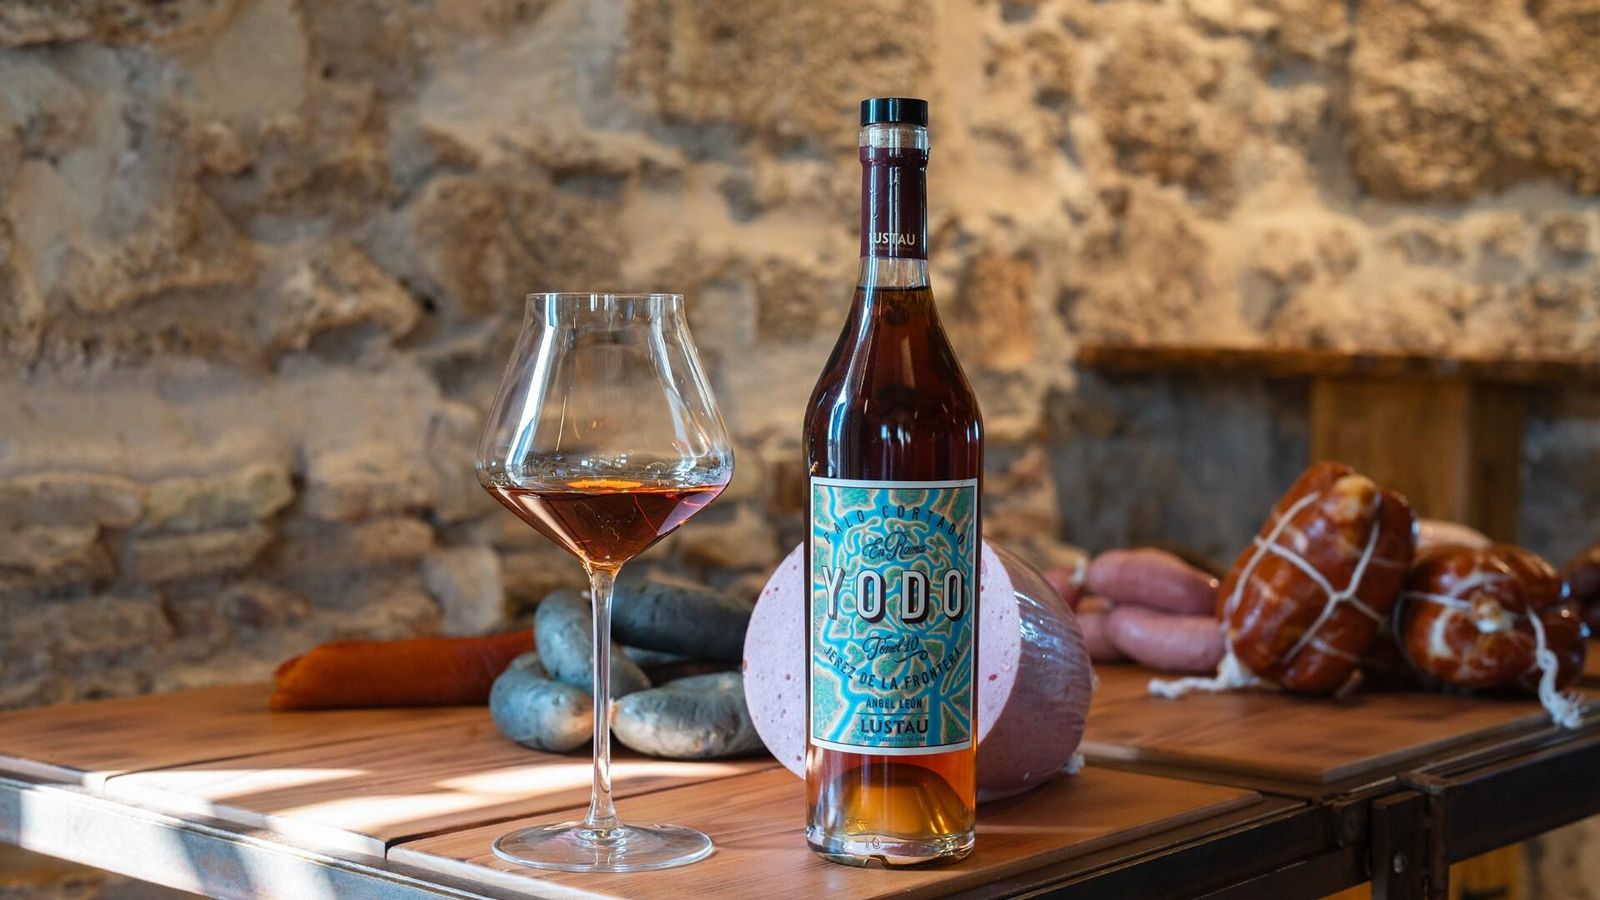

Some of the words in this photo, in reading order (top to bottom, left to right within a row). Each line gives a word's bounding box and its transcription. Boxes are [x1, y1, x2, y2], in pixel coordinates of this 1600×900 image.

[823, 510, 865, 544] PALO
[881, 505, 966, 545] CORTADO
[862, 537, 885, 560] En
[885, 531, 927, 561] Rama
[821, 565, 969, 624] YODO
[823, 646, 857, 679] JEREZ
[859, 673, 876, 687] DE
[881, 678, 898, 690] LA
[904, 647, 963, 689] FRONTERA
[860, 719, 929, 734] LUSTAU
